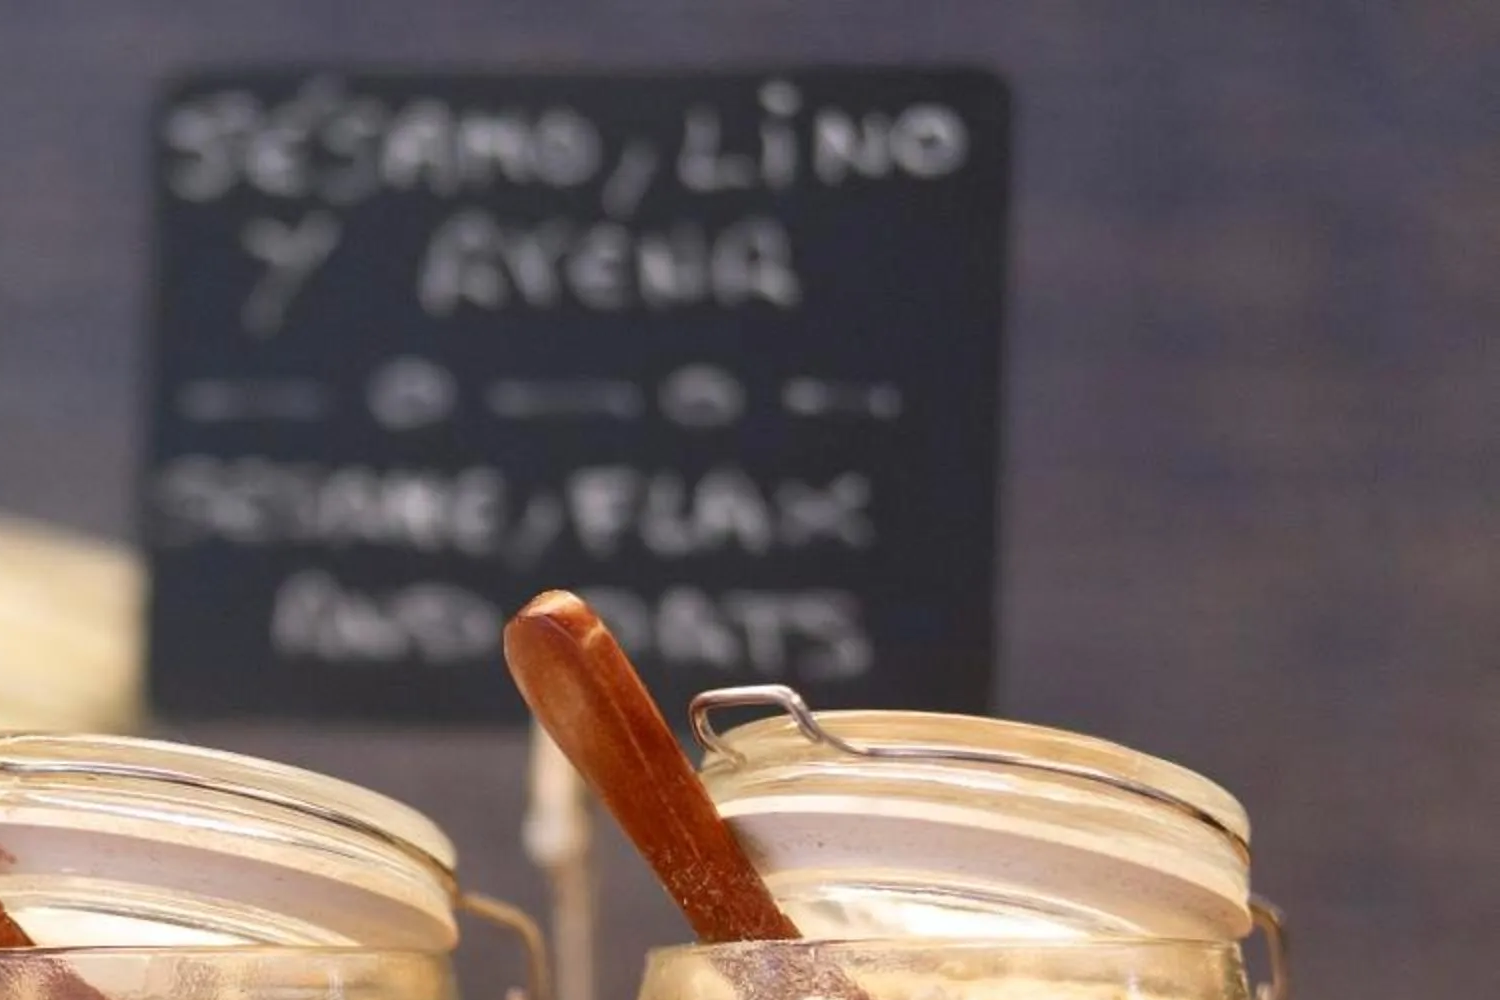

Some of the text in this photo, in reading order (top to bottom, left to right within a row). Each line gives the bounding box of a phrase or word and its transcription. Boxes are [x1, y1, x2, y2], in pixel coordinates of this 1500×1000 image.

[420, 210, 800, 312] AVENA
[566, 466, 874, 554] FLAX
[272, 570, 500, 660] AND
